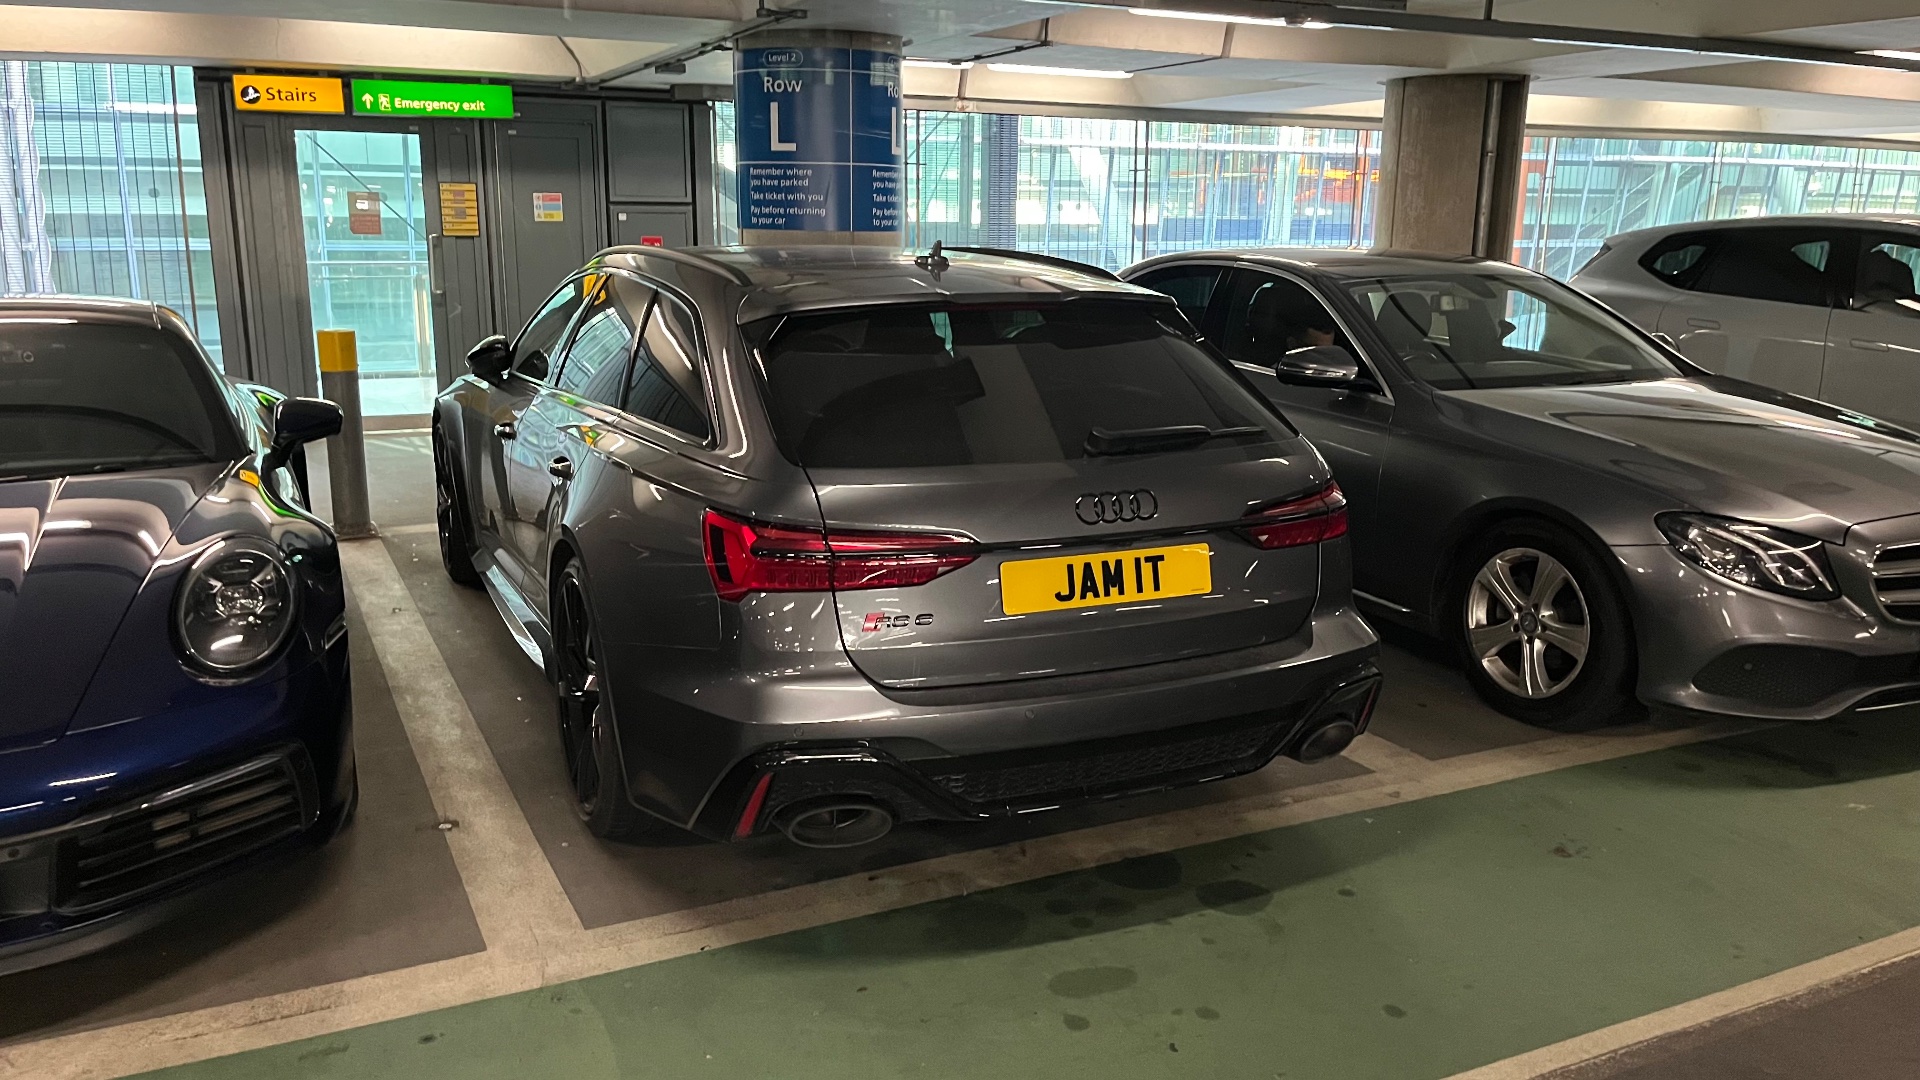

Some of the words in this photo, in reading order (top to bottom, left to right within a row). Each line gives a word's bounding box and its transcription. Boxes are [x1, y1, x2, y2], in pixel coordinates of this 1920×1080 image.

[769, 53, 789, 62] Level
[791, 53, 796, 61] 2
[763, 76, 802, 93] Row
[887, 82, 900, 98] Ro
[265, 87, 317, 102] Stairs
[394, 97, 460, 113] Emergency
[462, 99, 486, 112] exit
[770, 101, 797, 152] L
[891, 106, 902, 156] L
[750, 166, 784, 176] Remember
[786, 167, 812, 177] where
[750, 179, 761, 188] you
[762, 178, 779, 186] have
[780, 178, 809, 188] parked
[872, 181, 884, 190] you
[751, 191, 764, 200] Take
[765, 191, 785, 200] ticket
[786, 192, 806, 201] with
[807, 194, 824, 203] you
[872, 193, 886, 202] Take
[750, 205, 760, 215] Pay
[761, 205, 785, 215] before
[786, 206, 826, 217] returning
[872, 207, 883, 218] Pay
[751, 216, 758, 224] to
[758, 217, 773, 226] your
[774, 217, 786, 225] car
[873, 218, 880, 226] to
[1054, 559, 1125, 602] JAM
